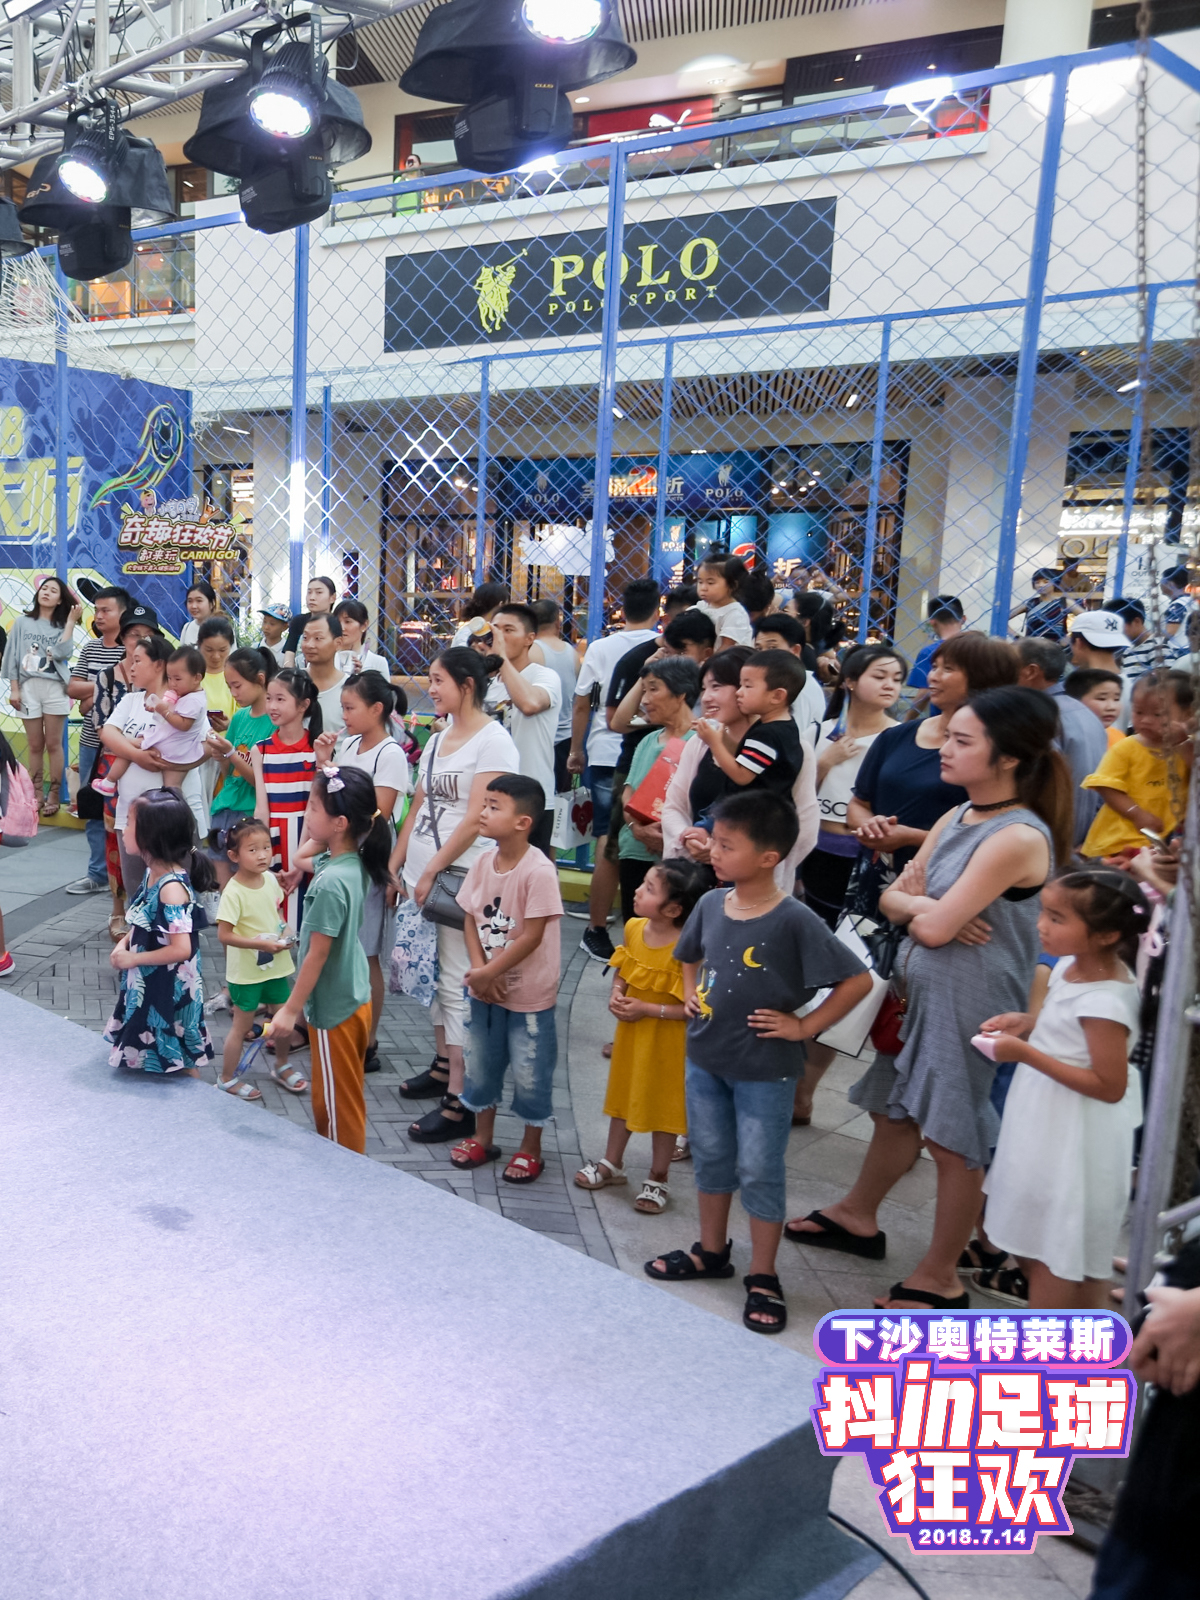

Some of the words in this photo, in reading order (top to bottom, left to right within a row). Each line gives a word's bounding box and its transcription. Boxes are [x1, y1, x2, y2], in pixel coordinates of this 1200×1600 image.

[549, 237, 719, 297] POLO
[548, 299, 606, 316] POL
[628, 285, 717, 306] SPORT
[705, 488, 743, 498] POLO
[120, 515, 233, 550] 奇趣狂欢节
[139, 548, 178, 561] 都来玩
